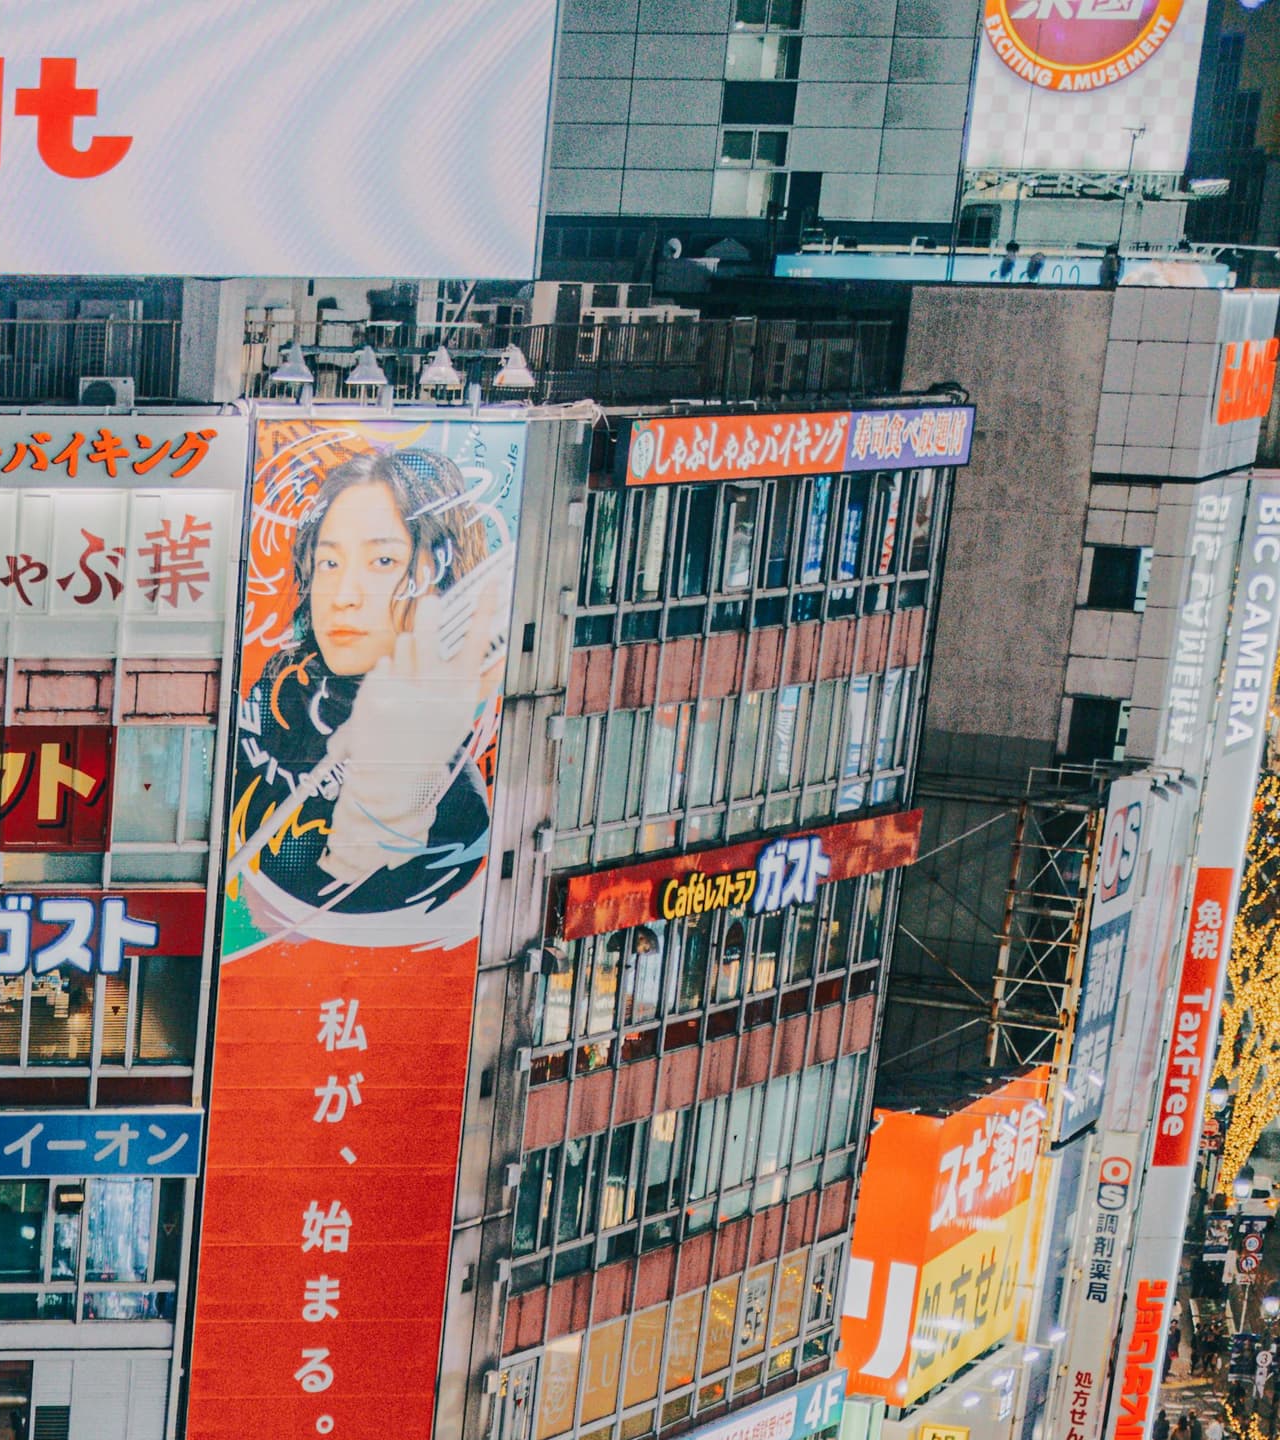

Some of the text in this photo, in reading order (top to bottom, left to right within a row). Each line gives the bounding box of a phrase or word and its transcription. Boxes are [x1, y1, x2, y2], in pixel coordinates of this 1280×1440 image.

[985, 14, 1172, 91] EXCITING AMUSEMENT
[654, 413, 849, 475] しゃぶしゃぶバイキング
[1225, 496, 1279, 748] BIC CAMERA
[753, 835, 831, 915] ガスト
[1190, 899, 1223, 960] 免税
[930, 1101, 1042, 1233] スギ薬局
[293, 997, 367, 1435] 私が、始まる。
[1086, 1213, 1119, 1304] 調剤薬局
[803, 1382, 839, 1430] 4F
